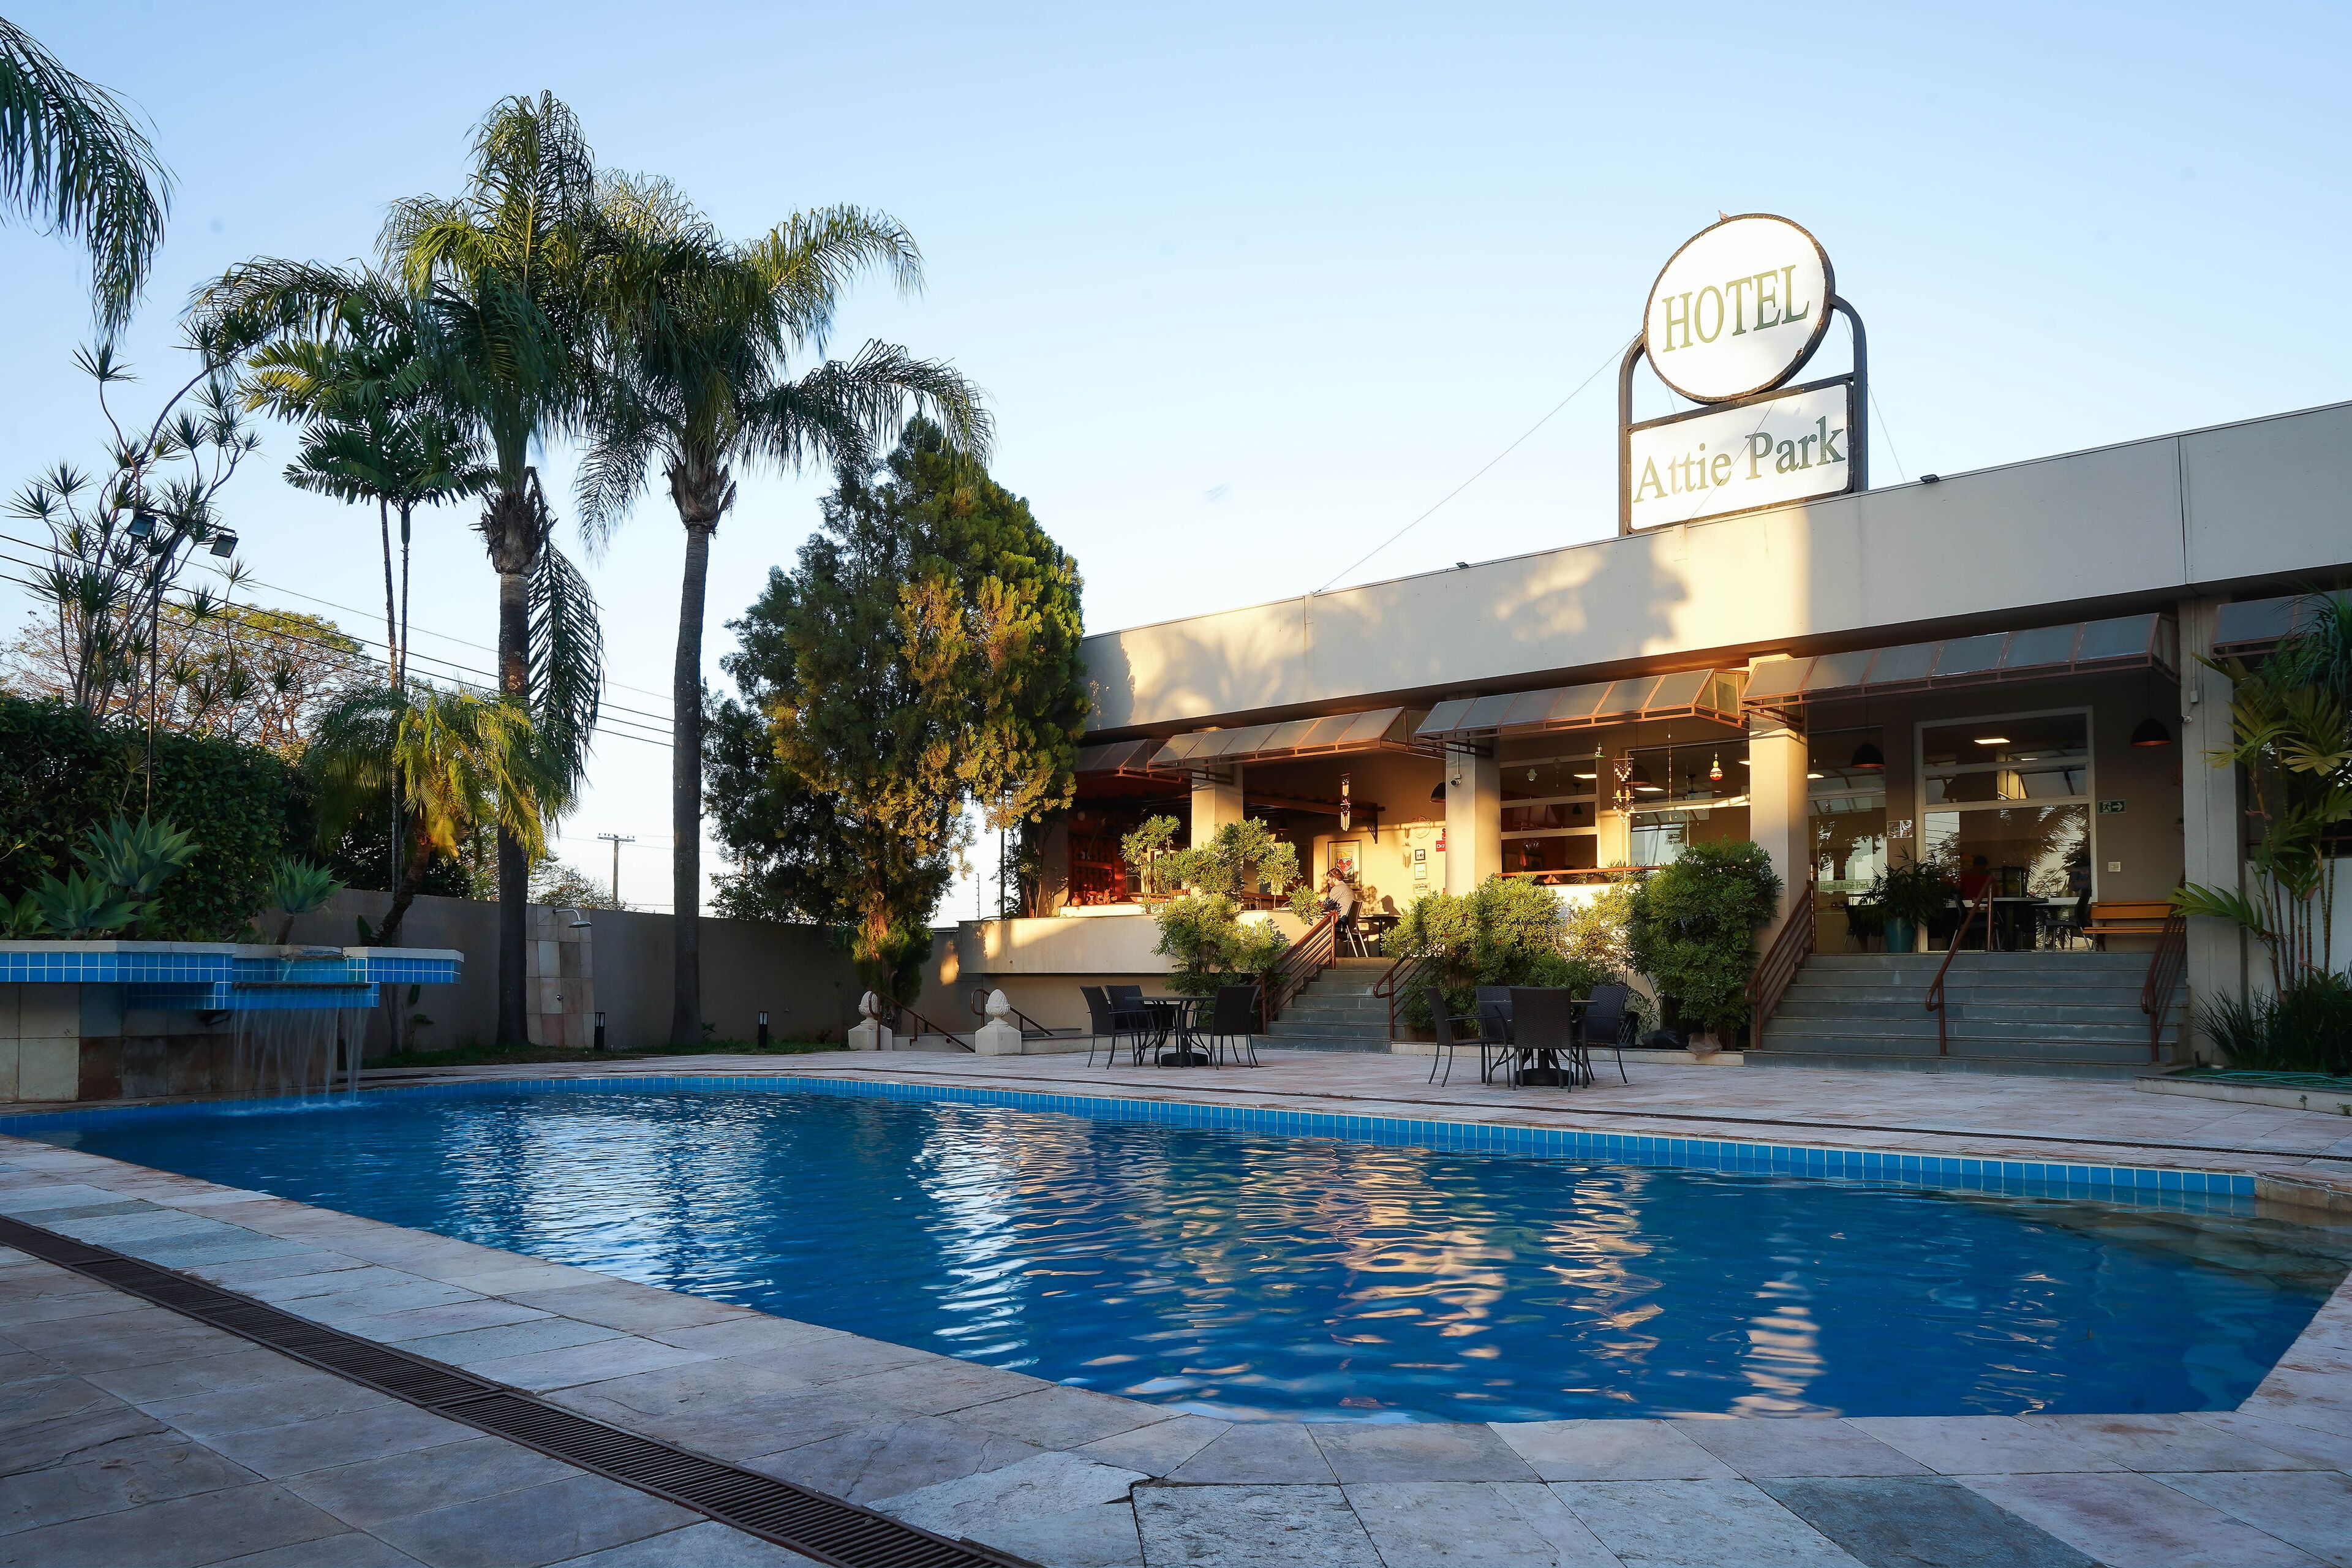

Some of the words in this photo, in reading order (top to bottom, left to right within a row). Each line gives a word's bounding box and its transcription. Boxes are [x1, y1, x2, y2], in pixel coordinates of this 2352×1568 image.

[1662, 265, 1809, 353] HOTEL
[1633, 443, 1732, 503] Attie
[1745, 416, 1845, 480] Park
[1820, 882, 1837, 891] Hotel
[1856, 881, 1870, 889] Park
